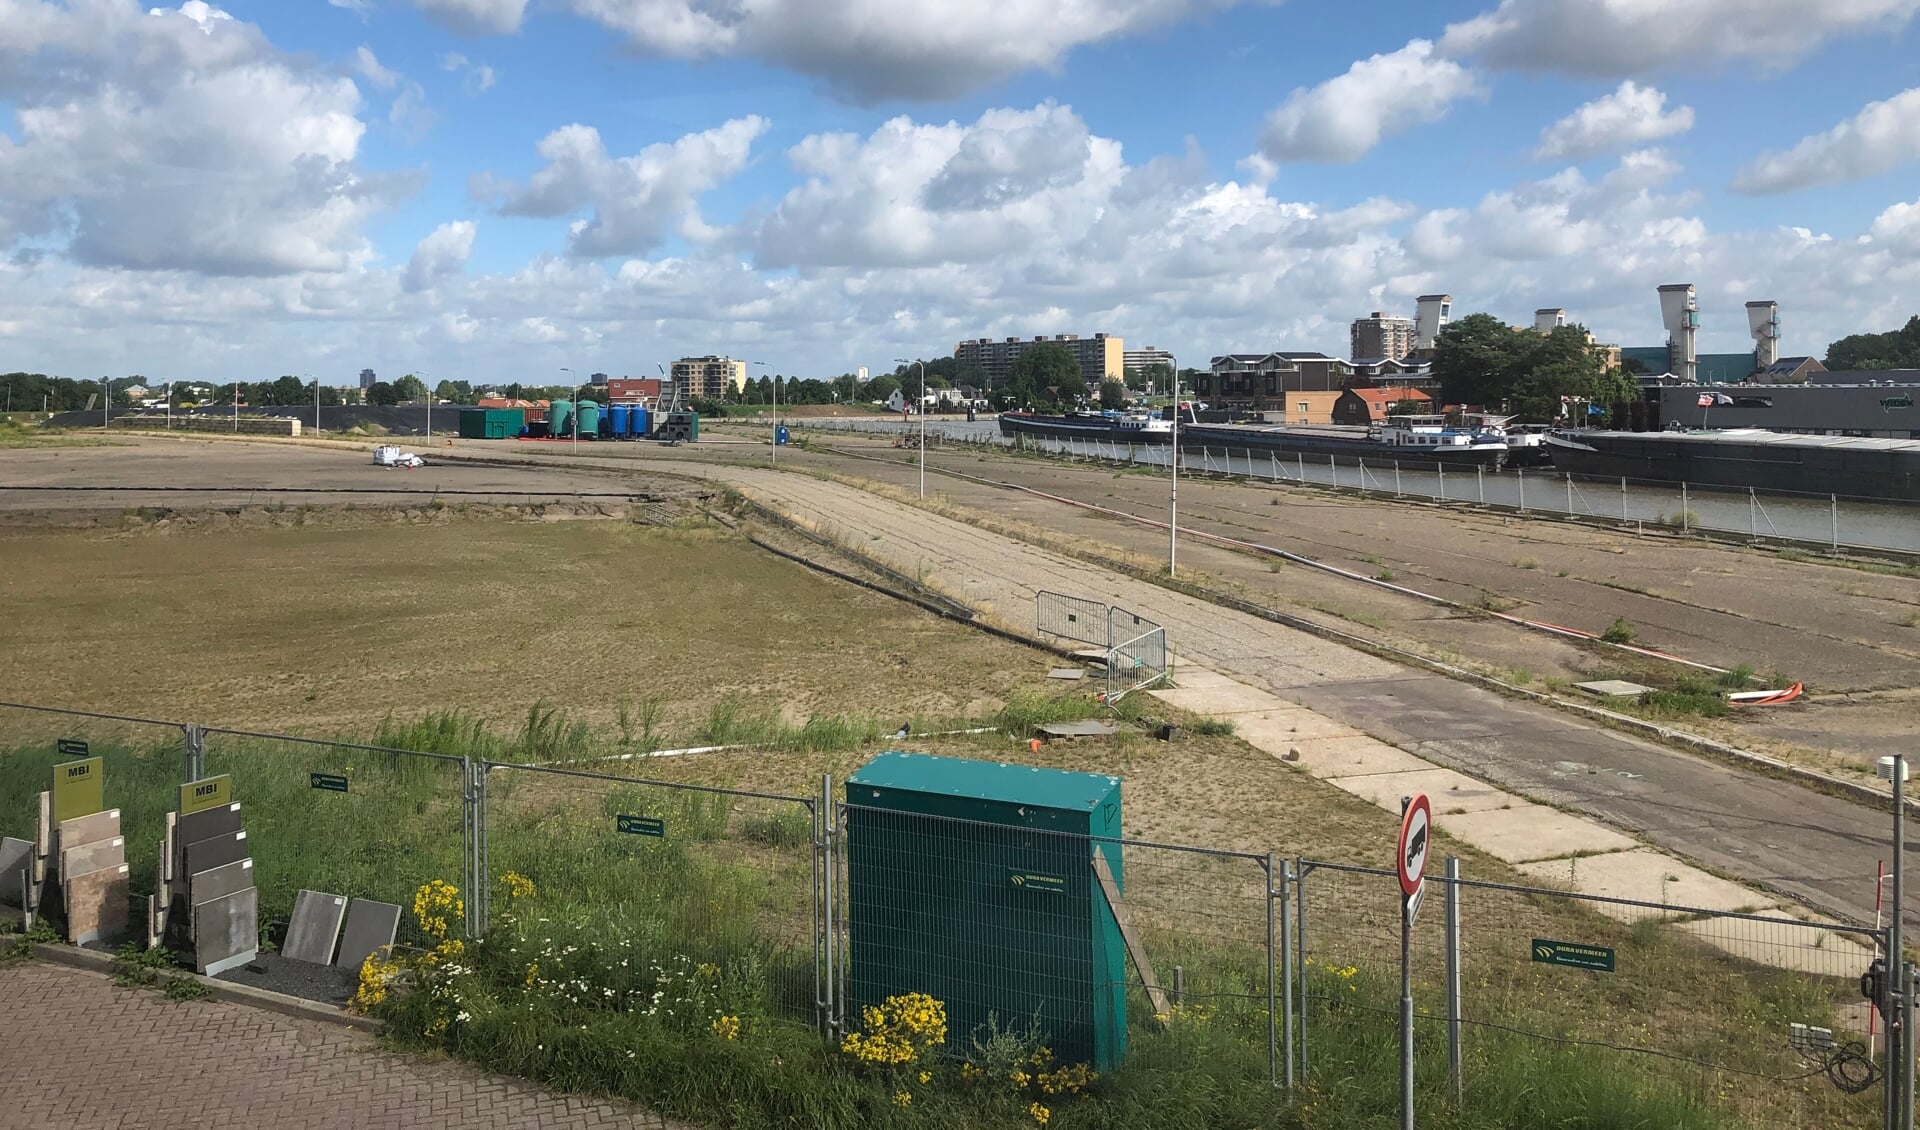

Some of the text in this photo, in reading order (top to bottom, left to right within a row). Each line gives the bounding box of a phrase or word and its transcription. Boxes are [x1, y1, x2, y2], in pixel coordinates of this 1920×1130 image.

[68, 765, 90, 778] MBI
[195, 783, 218, 797] MBI
[1556, 945, 1608, 958] DURA VERMEER
